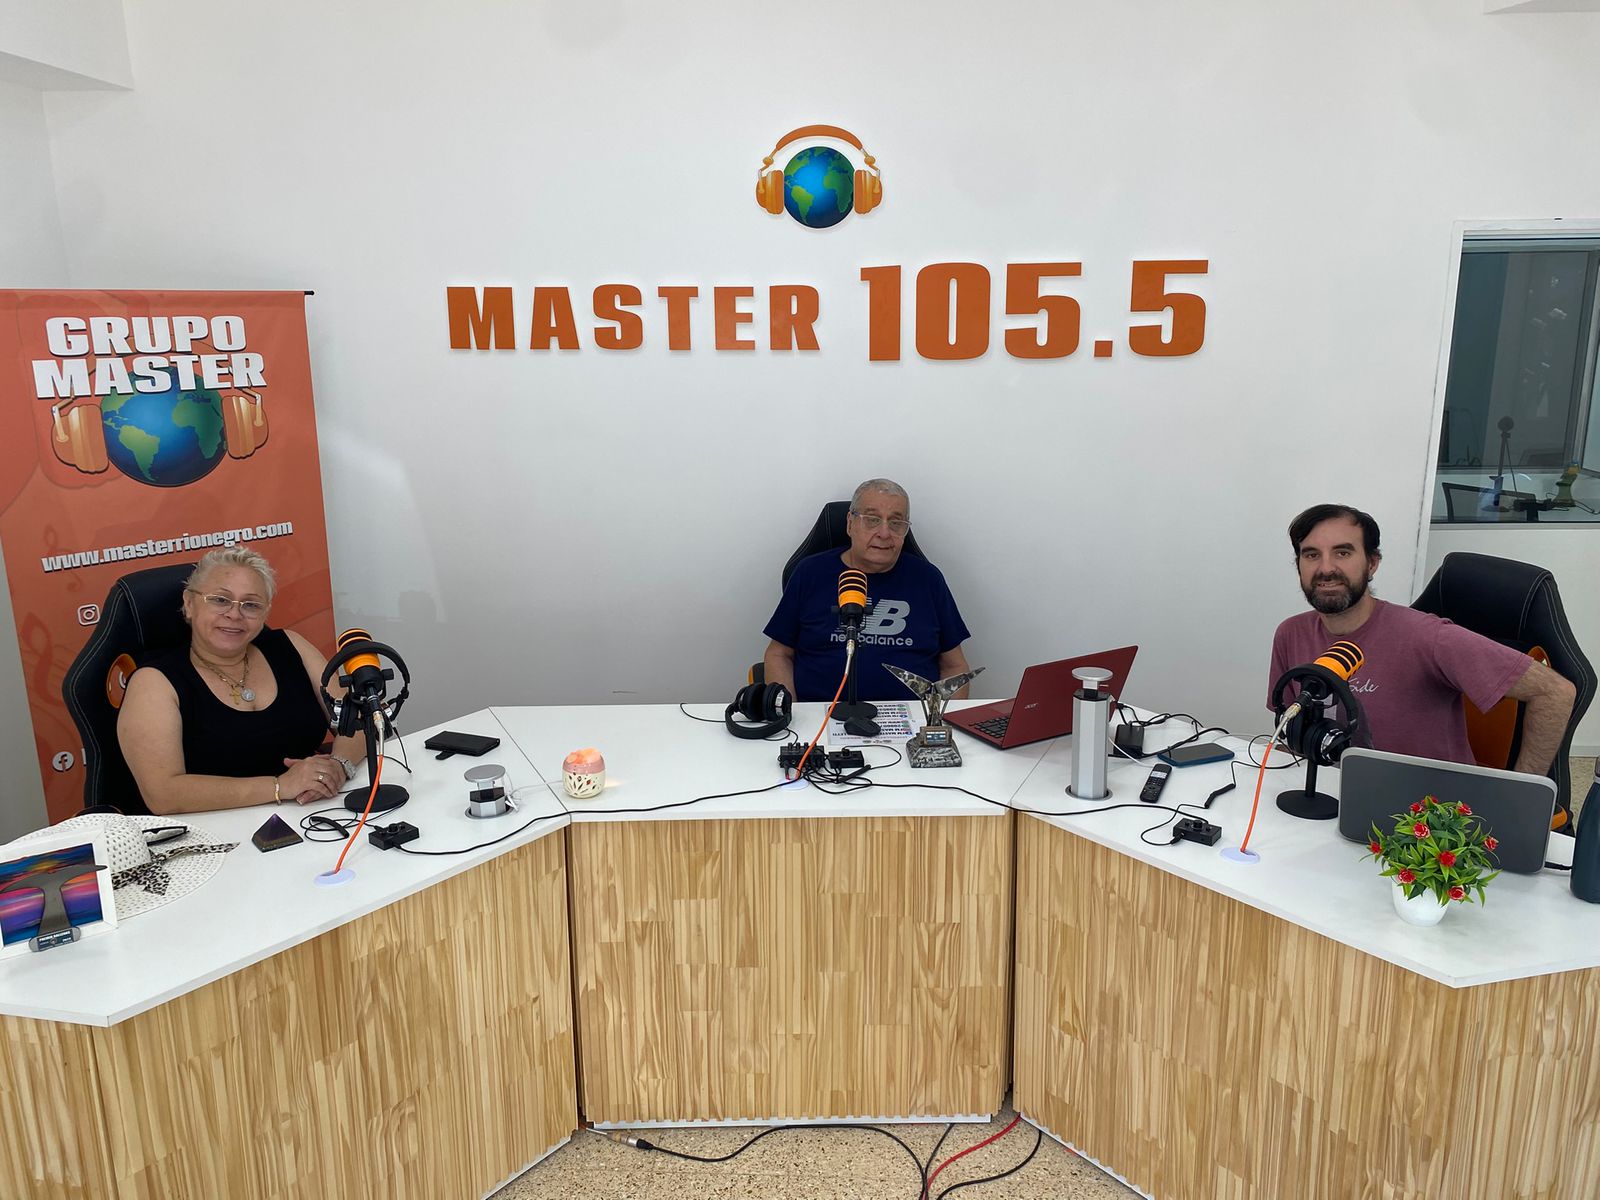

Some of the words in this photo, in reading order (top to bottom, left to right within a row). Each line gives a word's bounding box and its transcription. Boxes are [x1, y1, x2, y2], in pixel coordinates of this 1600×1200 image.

[447, 284, 821, 351] MASTER
[860, 259, 1209, 361] 105.5
[45, 315, 247, 356] GRUPO
[32, 353, 267, 398] MASTER
[41, 521, 293, 571] www.masterrionegro.com
[857, 632, 913, 646] balance
